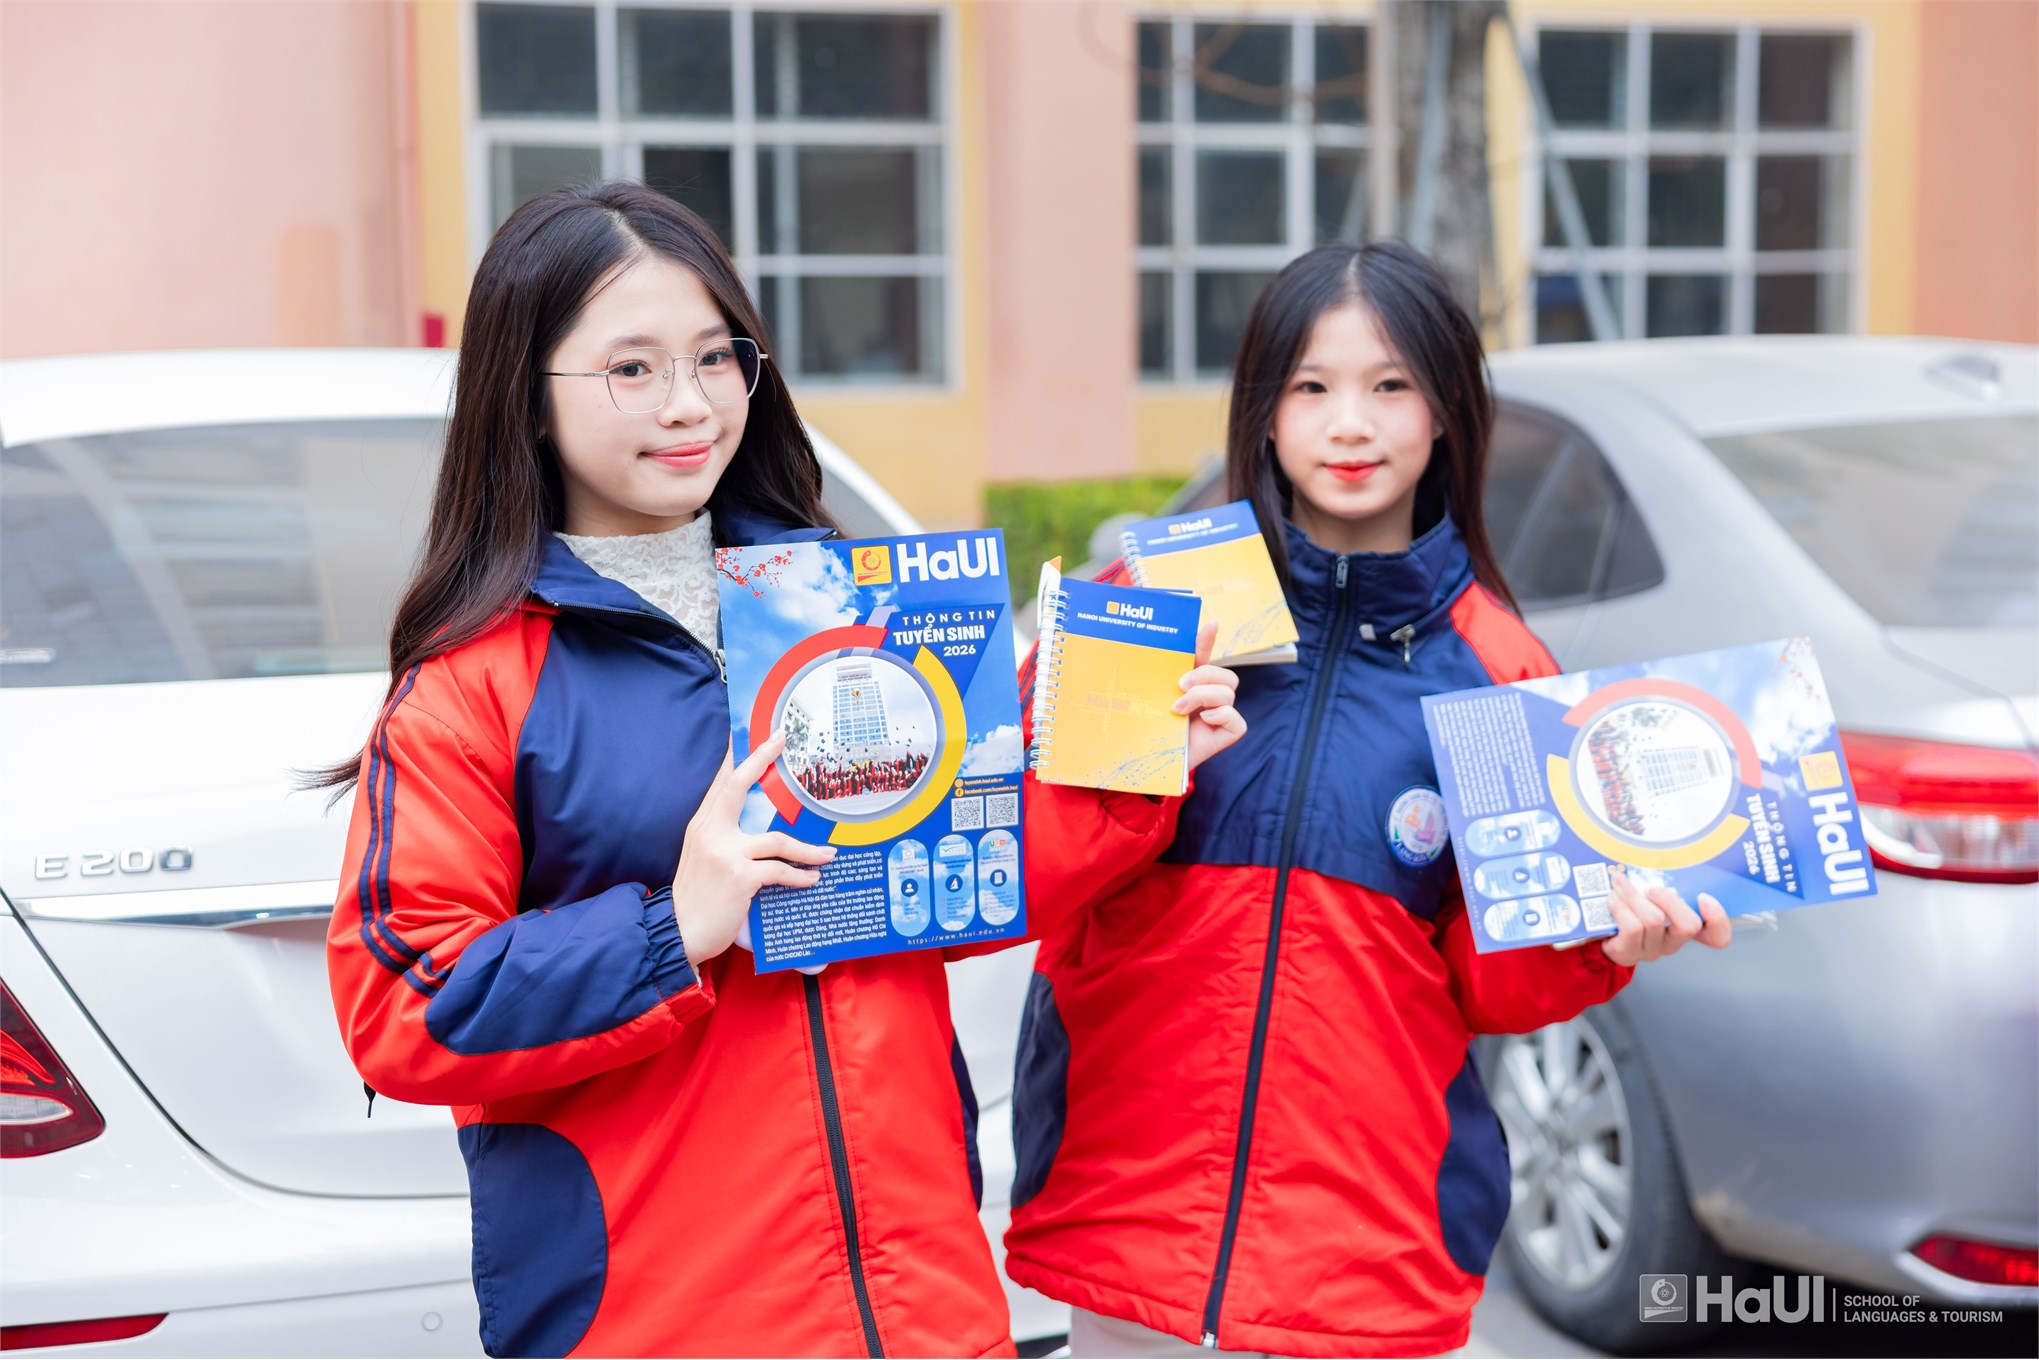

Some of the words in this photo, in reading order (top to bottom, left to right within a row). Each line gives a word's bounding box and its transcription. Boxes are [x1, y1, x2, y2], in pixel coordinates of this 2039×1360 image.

[896, 537, 1000, 583] HaUI
[902, 612, 962, 626] THÔNG
[968, 610, 995, 620] TIN
[1077, 612, 1098, 620] HANOI
[1098, 614, 1136, 628] UNIVERSITY
[1146, 624, 1178, 634] INDUSTRY
[1120, 602, 1154, 620] HaUI
[892, 624, 945, 646] TUYỂN
[946, 625, 986, 642] SINH
[943, 644, 976, 657] 2026
[1746, 793, 1774, 844] TUYỂN
[1743, 841, 1760, 876] 2026
[1767, 801, 1790, 860] THÔNG
[1782, 864, 1797, 892] TIN
[1808, 792, 1870, 896] HaUI
[34, 853, 68, 879] E
[80, 846, 192, 877] 200
[1759, 842, 1780, 884] SINH
[907, 928, 1005, 945] https://www.haui.edu.vn
